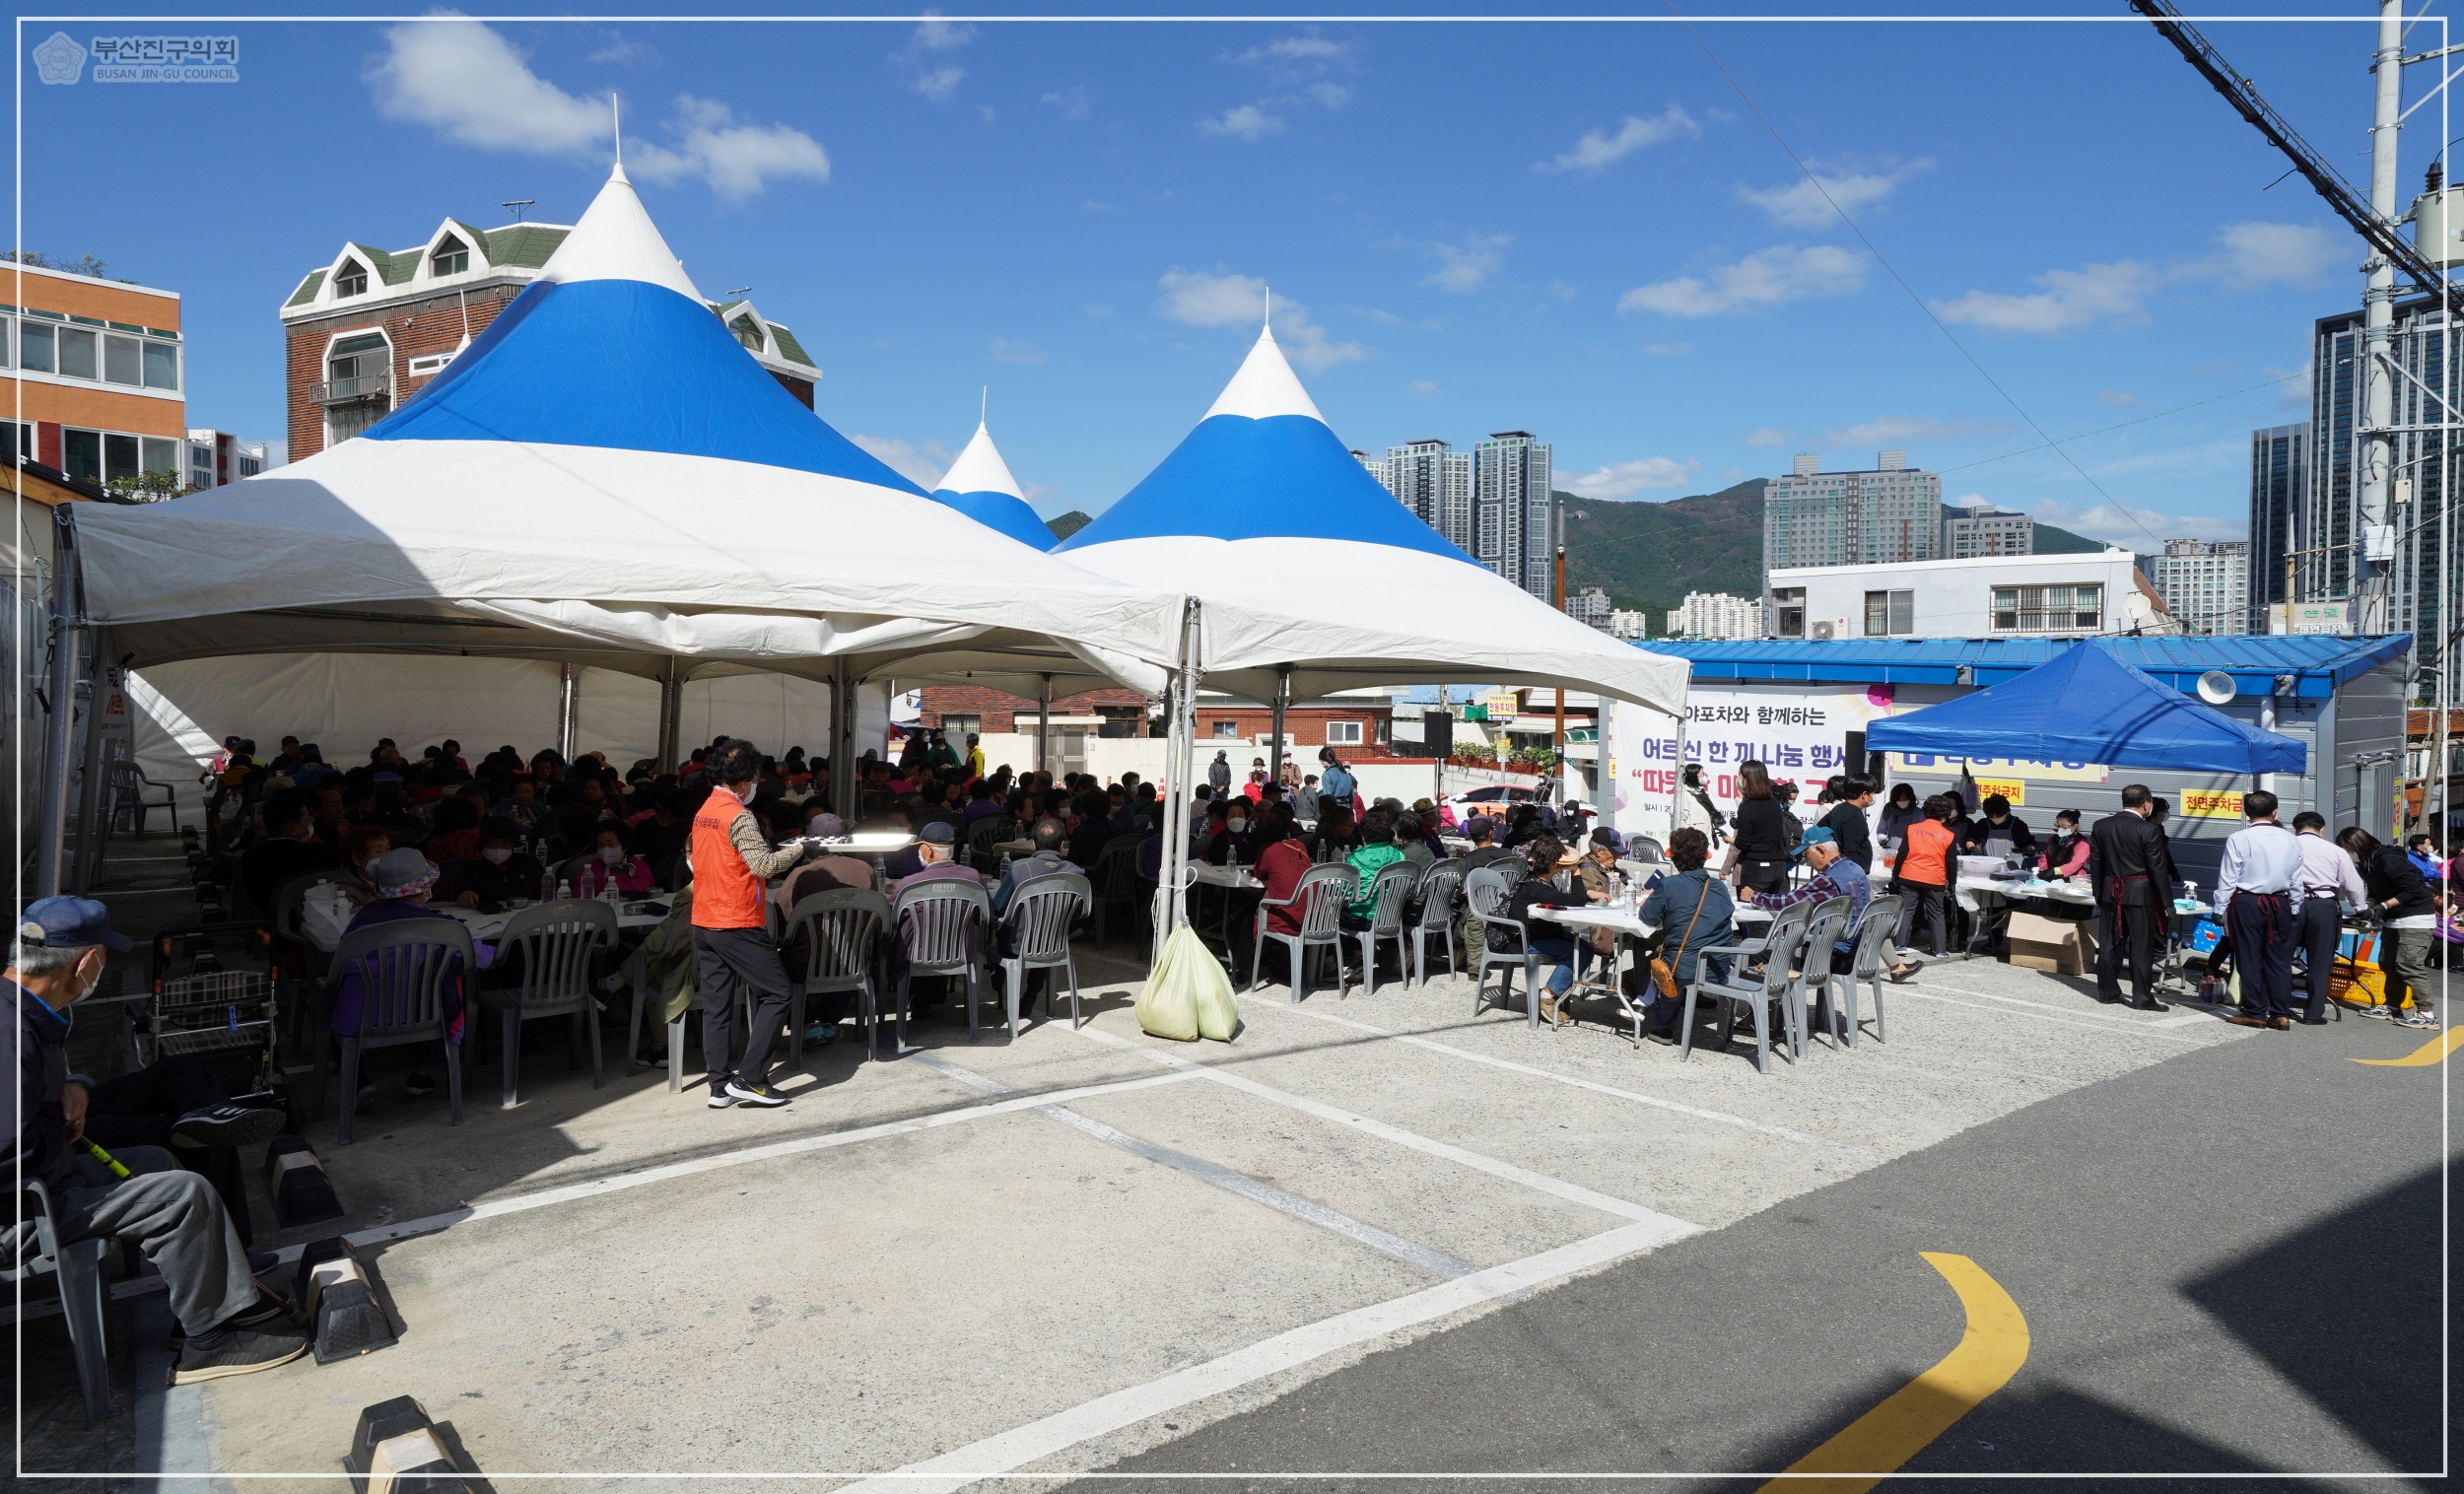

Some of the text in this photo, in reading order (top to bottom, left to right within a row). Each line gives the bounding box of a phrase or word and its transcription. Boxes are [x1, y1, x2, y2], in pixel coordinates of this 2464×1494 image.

[1668, 706, 1826, 726] 야포차와 함께하는
[1643, 737, 1702, 763] 어르신
[1708, 740, 1729, 764] 한
[1734, 742, 1755, 764] 끼
[1761, 743, 1804, 768] 나눔
[1644, 803, 1658, 813] 일시
[2186, 795, 2242, 813] 전면주차금
